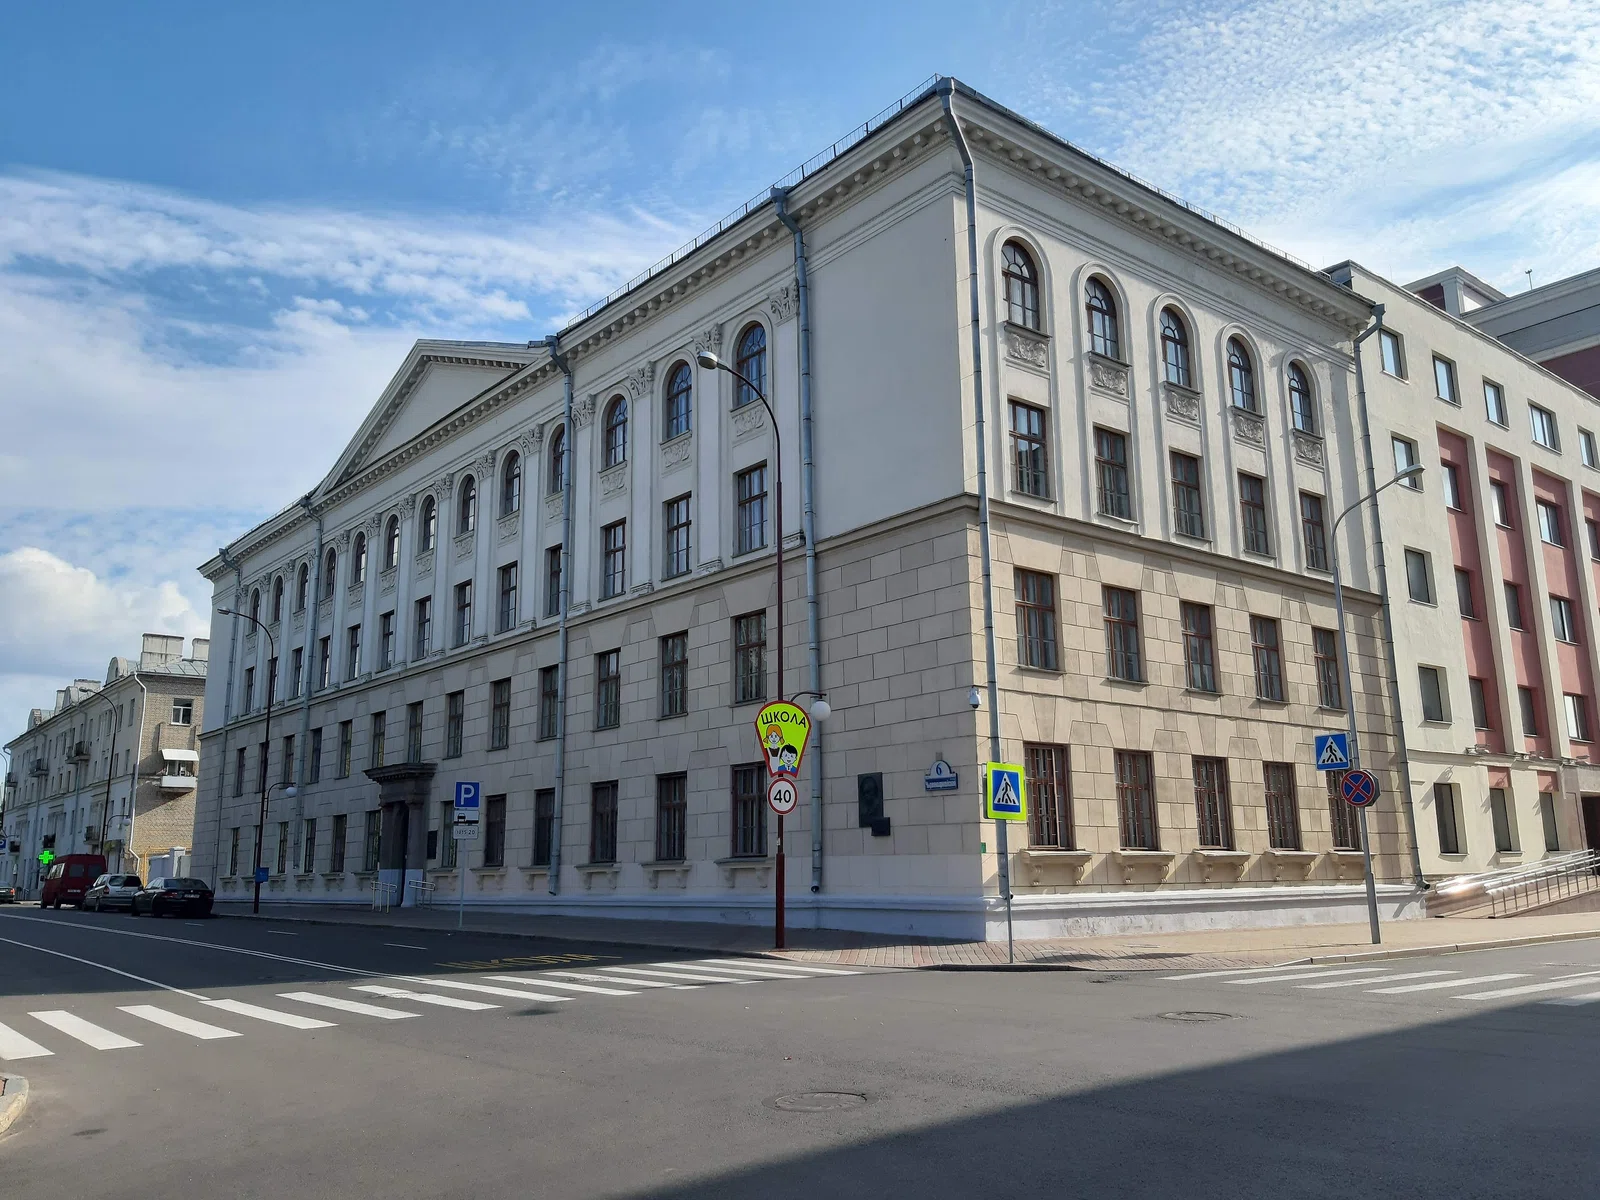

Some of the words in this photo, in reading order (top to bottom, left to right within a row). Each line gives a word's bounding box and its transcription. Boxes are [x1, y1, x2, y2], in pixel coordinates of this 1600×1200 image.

[760, 711, 806, 728] ШКОЛА
[936, 762, 942, 776] 6
[461, 784, 475, 805] P
[773, 789, 792, 803] 40
